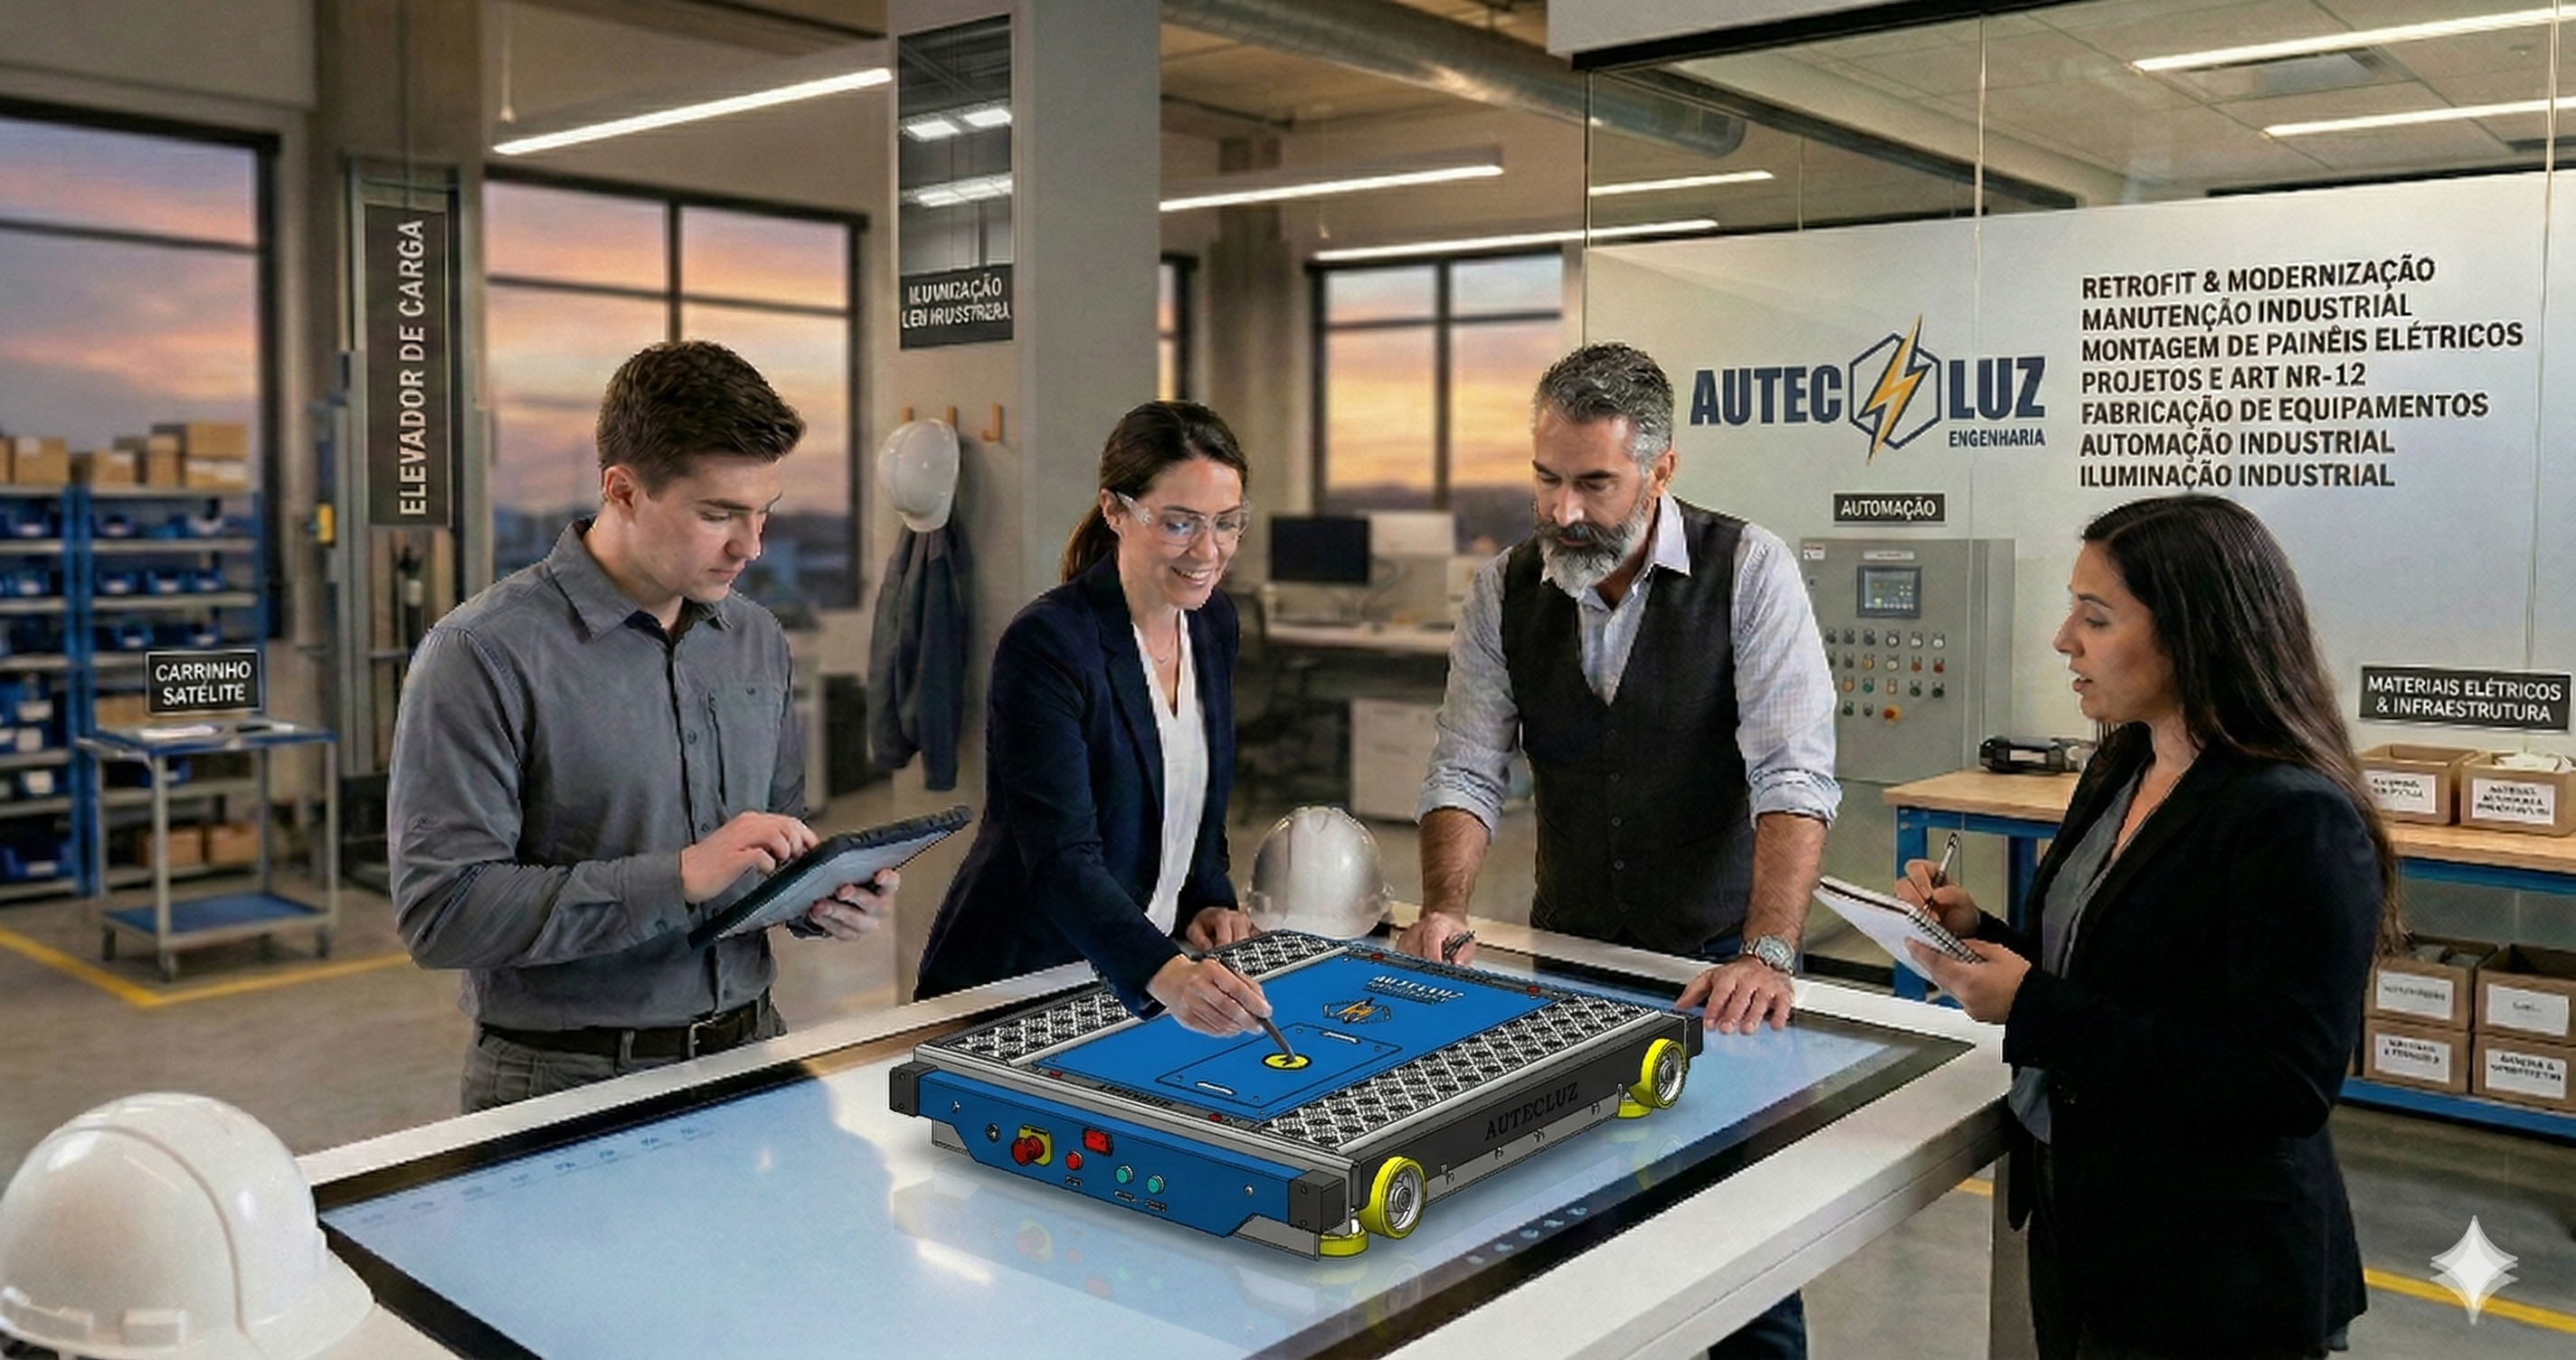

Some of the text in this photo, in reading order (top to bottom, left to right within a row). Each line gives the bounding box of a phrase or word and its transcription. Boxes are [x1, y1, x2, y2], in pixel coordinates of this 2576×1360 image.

[2082, 254, 2436, 299] RETROFIT & MODERNIZAÇÃO
[2082, 293, 2413, 331] MANUTENÇÃO INDUSTRIAL
[2082, 335, 2220, 362] MONTAGEM
[2227, 333, 2259, 357] DE
[2374, 320, 2524, 352] ELÉTRICOS
[397, 220, 427, 515] ELEVADOR DE CARGA
[2082, 362, 2366, 393] PROJETOS E ART NR-12
[2081, 392, 2489, 430] FABRICAÇÃO DE EQUIPAMENTOS
[1948, 429, 2046, 448] ENGENHARIA
[2079, 427, 2395, 462] AUTOMAÇÃO INDUSTRIAL
[2079, 458, 2395, 490] ILUMINAÇÃO INDUSTRIAL
[1841, 497, 1937, 521] AUTOMAÇÃO
[155, 660, 251, 682] CARRINHO
[162, 679, 246, 706] SATÉLITE
[2367, 675, 2562, 701] MATERIAIS ELÉTRICOS
[2376, 698, 2552, 722] & INFRAESTRUTURA
[1484, 1081, 1578, 1142] AUTECLUZ
